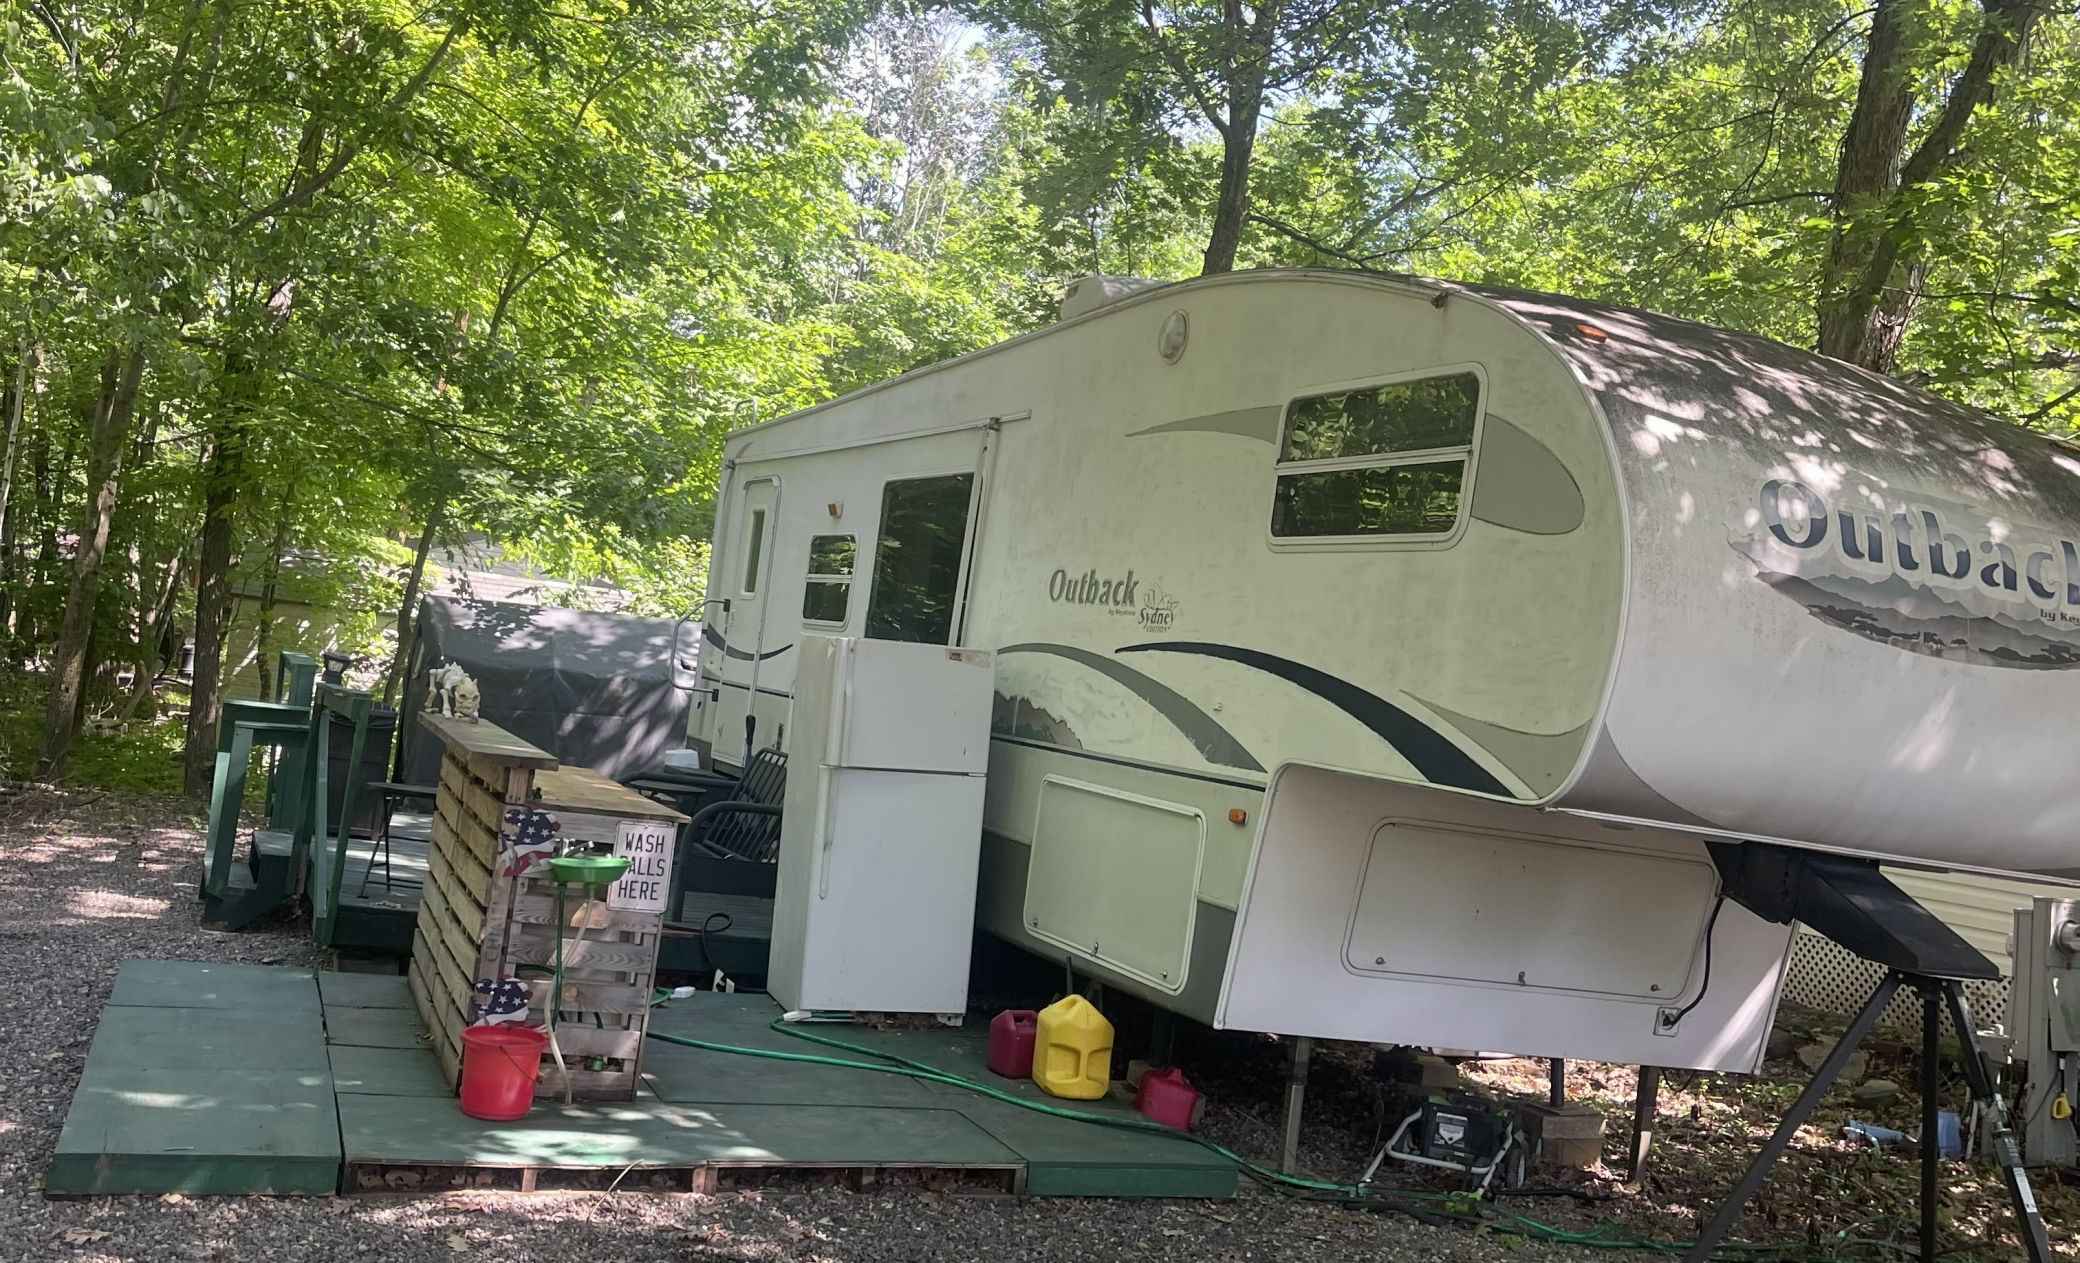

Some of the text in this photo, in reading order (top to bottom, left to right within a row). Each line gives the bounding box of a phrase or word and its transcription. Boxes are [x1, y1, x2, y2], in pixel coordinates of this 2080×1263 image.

[1049, 568, 1140, 607] Outback
[1138, 607, 1177, 630] Sydney
[2040, 608, 2056, 622] by
[625, 832, 666, 854] WASH
[617, 879, 661, 901] HERE
